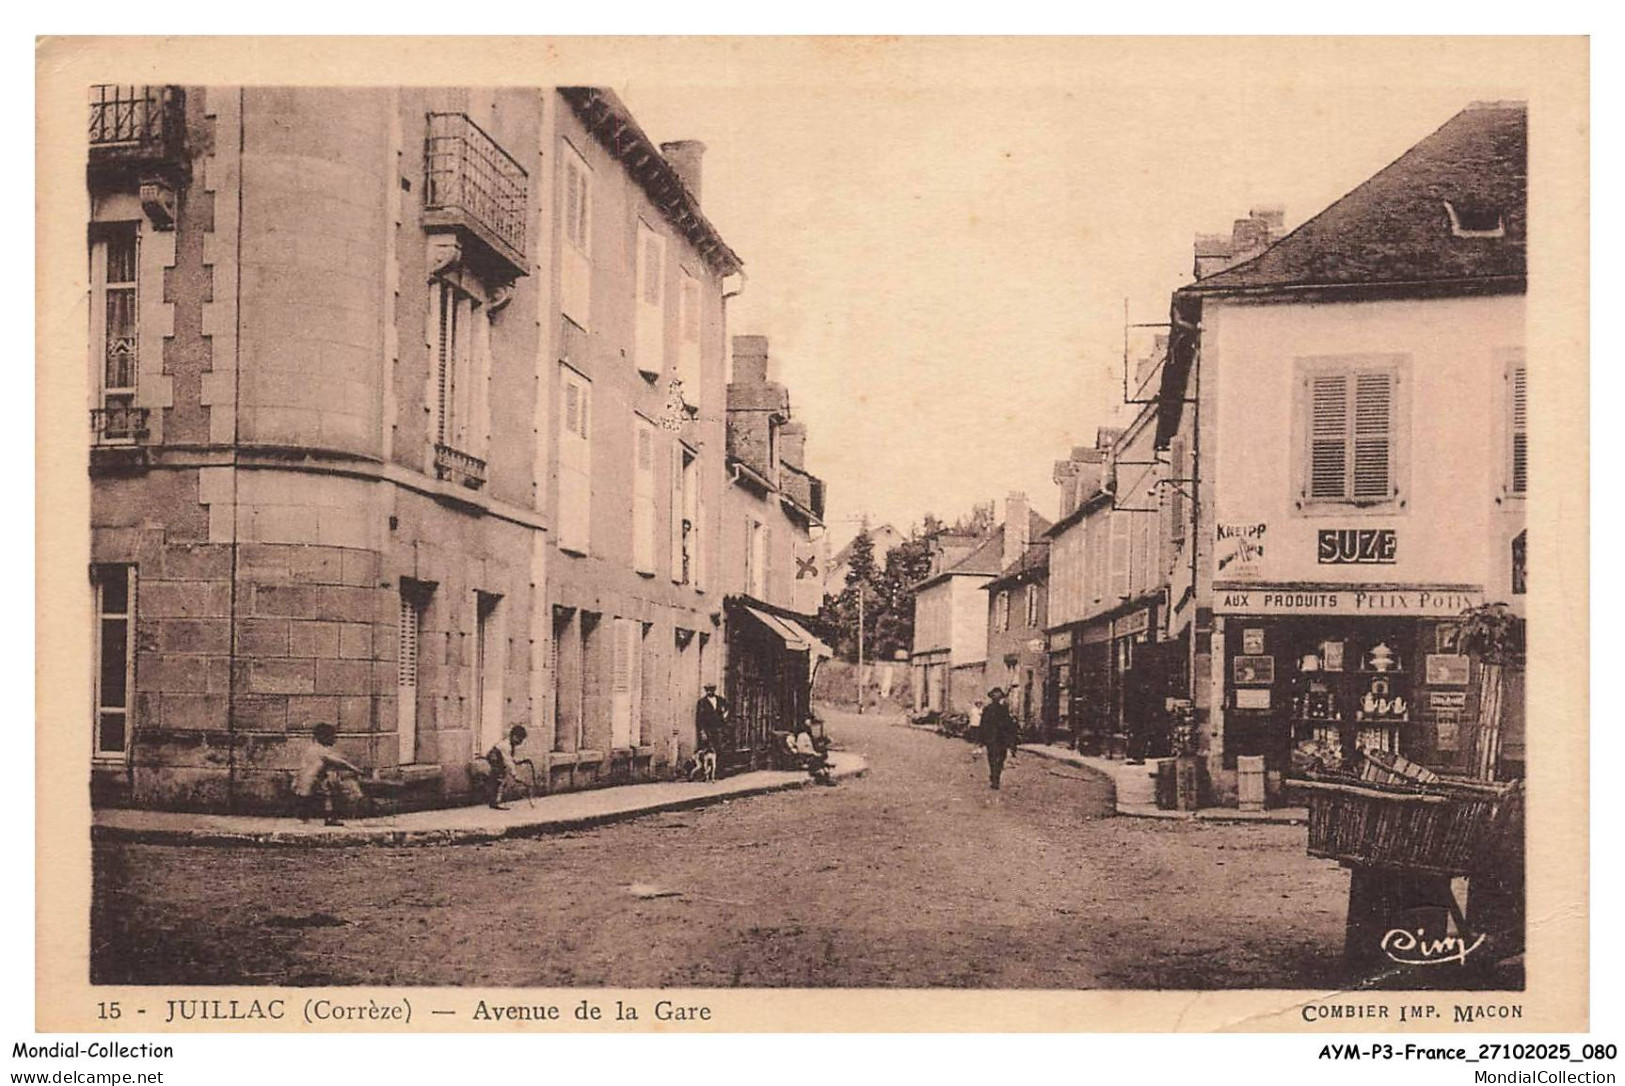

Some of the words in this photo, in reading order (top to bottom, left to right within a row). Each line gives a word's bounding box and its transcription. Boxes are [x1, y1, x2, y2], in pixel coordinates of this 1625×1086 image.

[1217, 523, 1267, 541] KNEIPP
[1319, 530, 1396, 563] SUZE
[1223, 595, 1249, 607] AUX
[1264, 594, 1338, 608] PRODUITS
